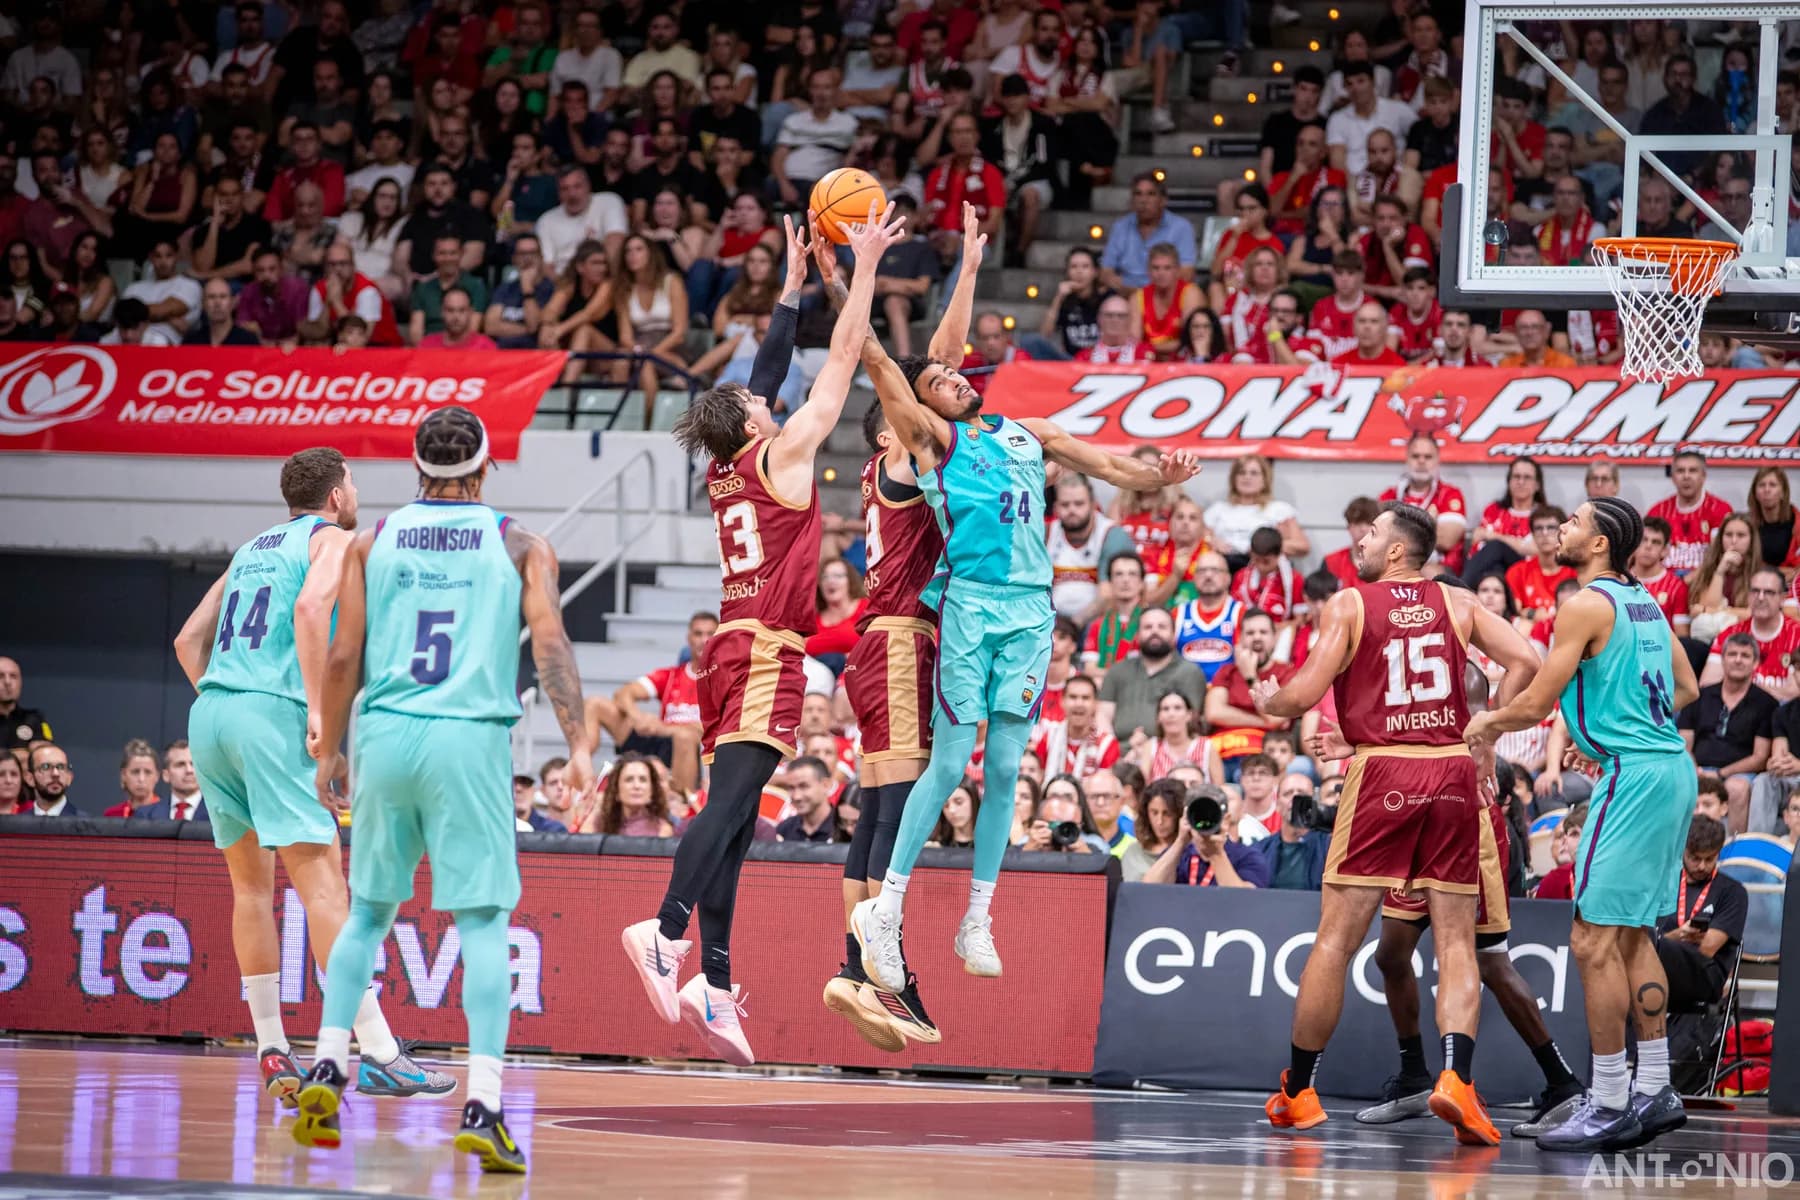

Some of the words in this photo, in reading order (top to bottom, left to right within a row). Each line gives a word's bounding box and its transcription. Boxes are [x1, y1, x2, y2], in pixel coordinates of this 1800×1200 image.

[139, 369, 213, 398] OC
[218, 370, 486, 401] Soluciones
[1047, 374, 1384, 440] ZONA
[396, 525, 483, 552] ROBINSON
[1000, 491, 1031, 524] 24
[218, 586, 272, 653] 44
[410, 610, 455, 686] 5
[1383, 633, 1452, 707] 15
[1386, 705, 1456, 732] INVERSUS
[73, 883, 192, 1000] te
